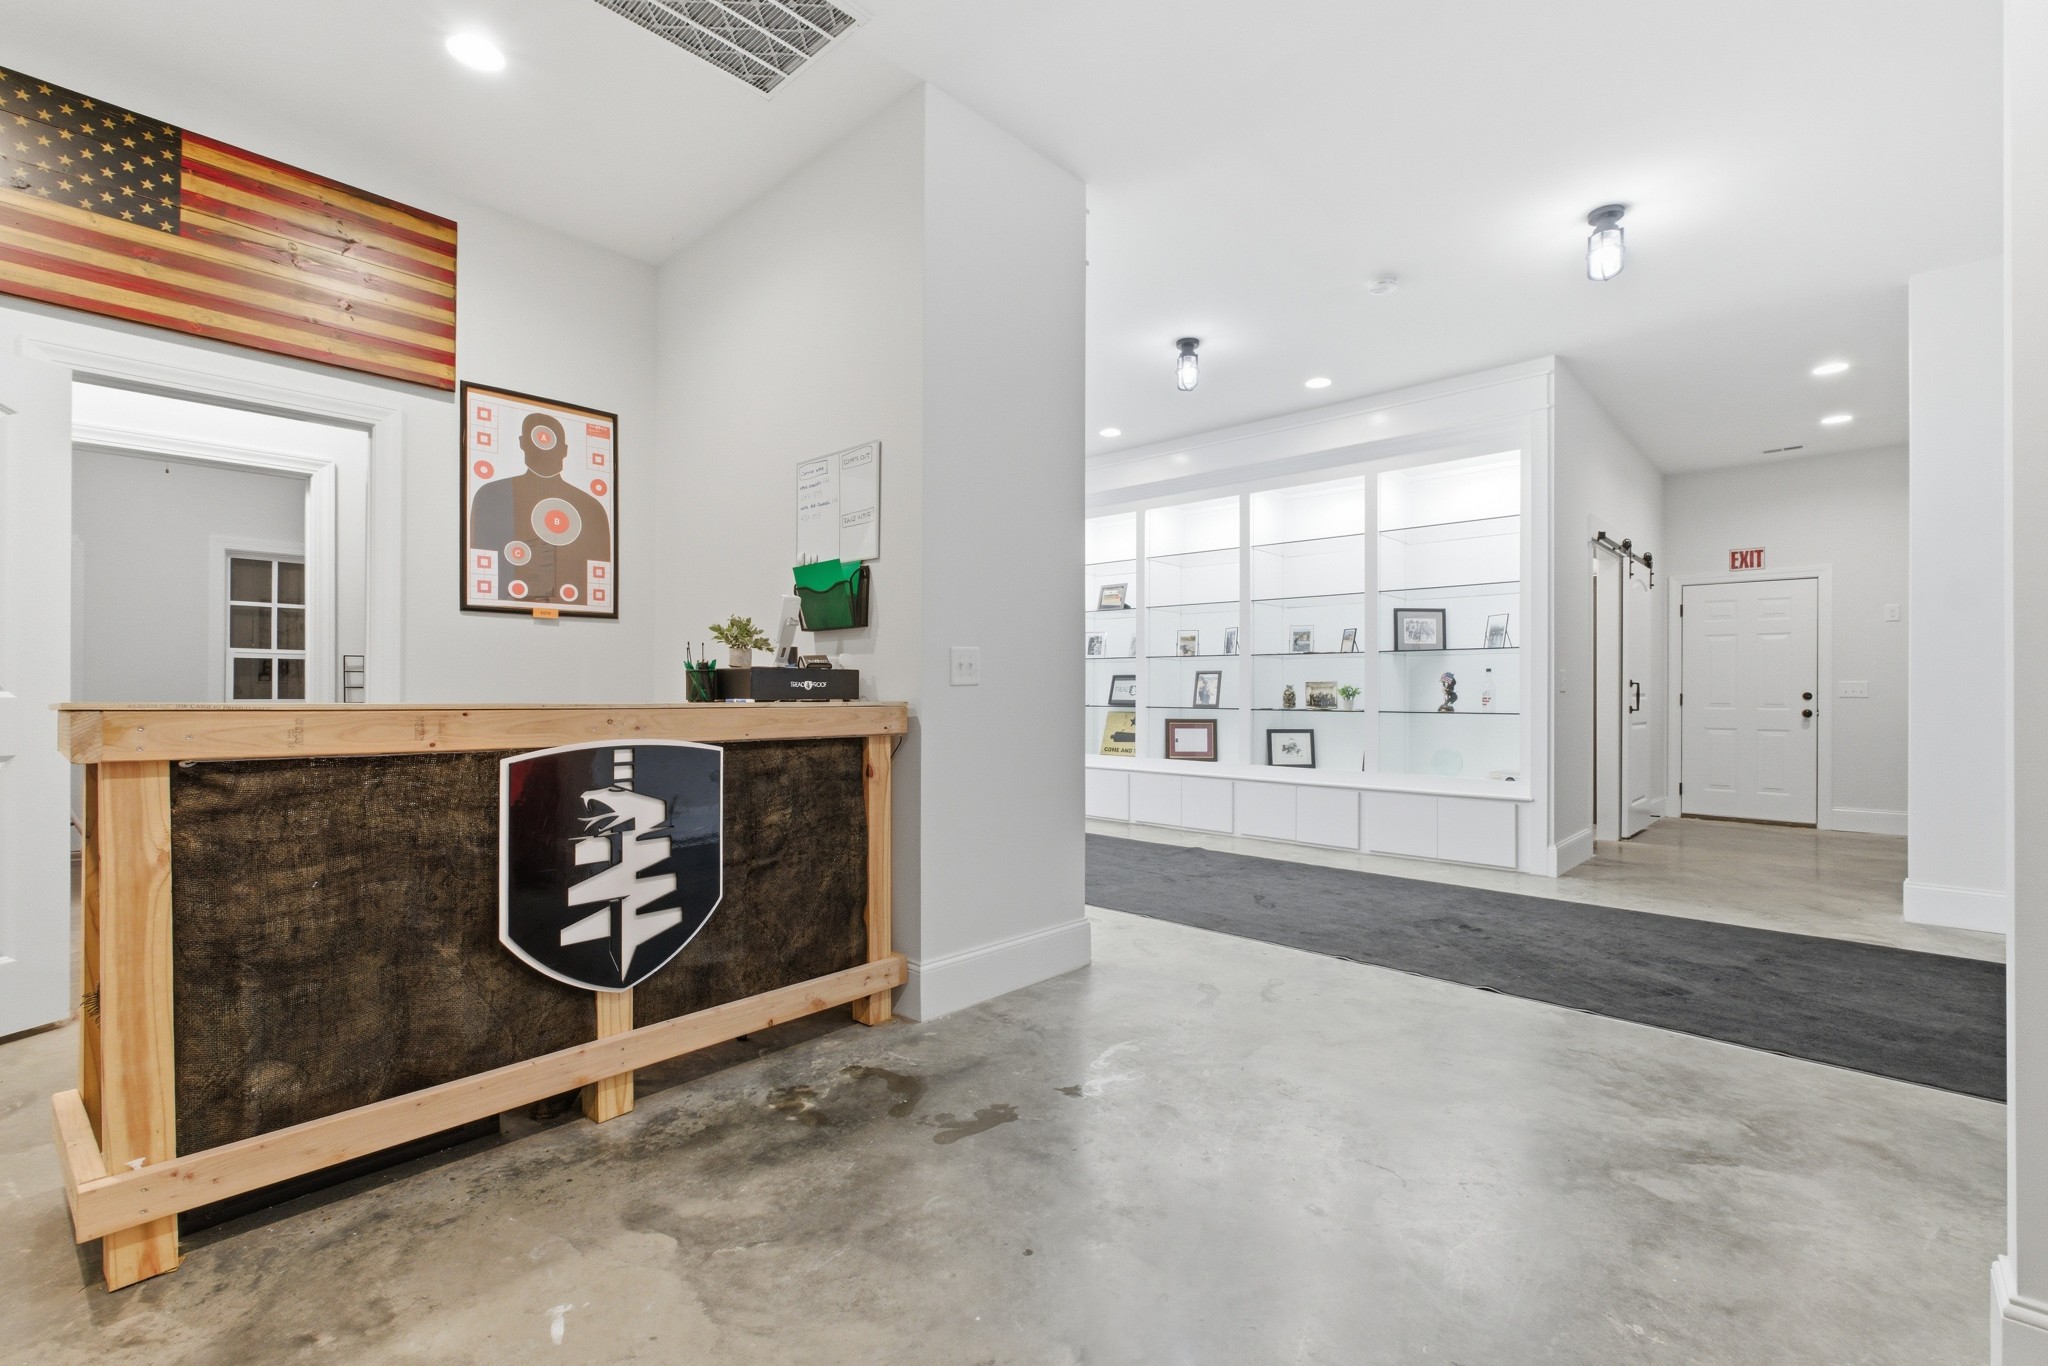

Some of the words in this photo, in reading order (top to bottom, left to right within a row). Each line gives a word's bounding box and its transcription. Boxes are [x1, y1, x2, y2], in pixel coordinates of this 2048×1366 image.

[541, 433, 548, 442] A
[553, 517, 560, 526] B
[514, 549, 521, 557] C
[1731, 550, 1764, 570] EXIT
